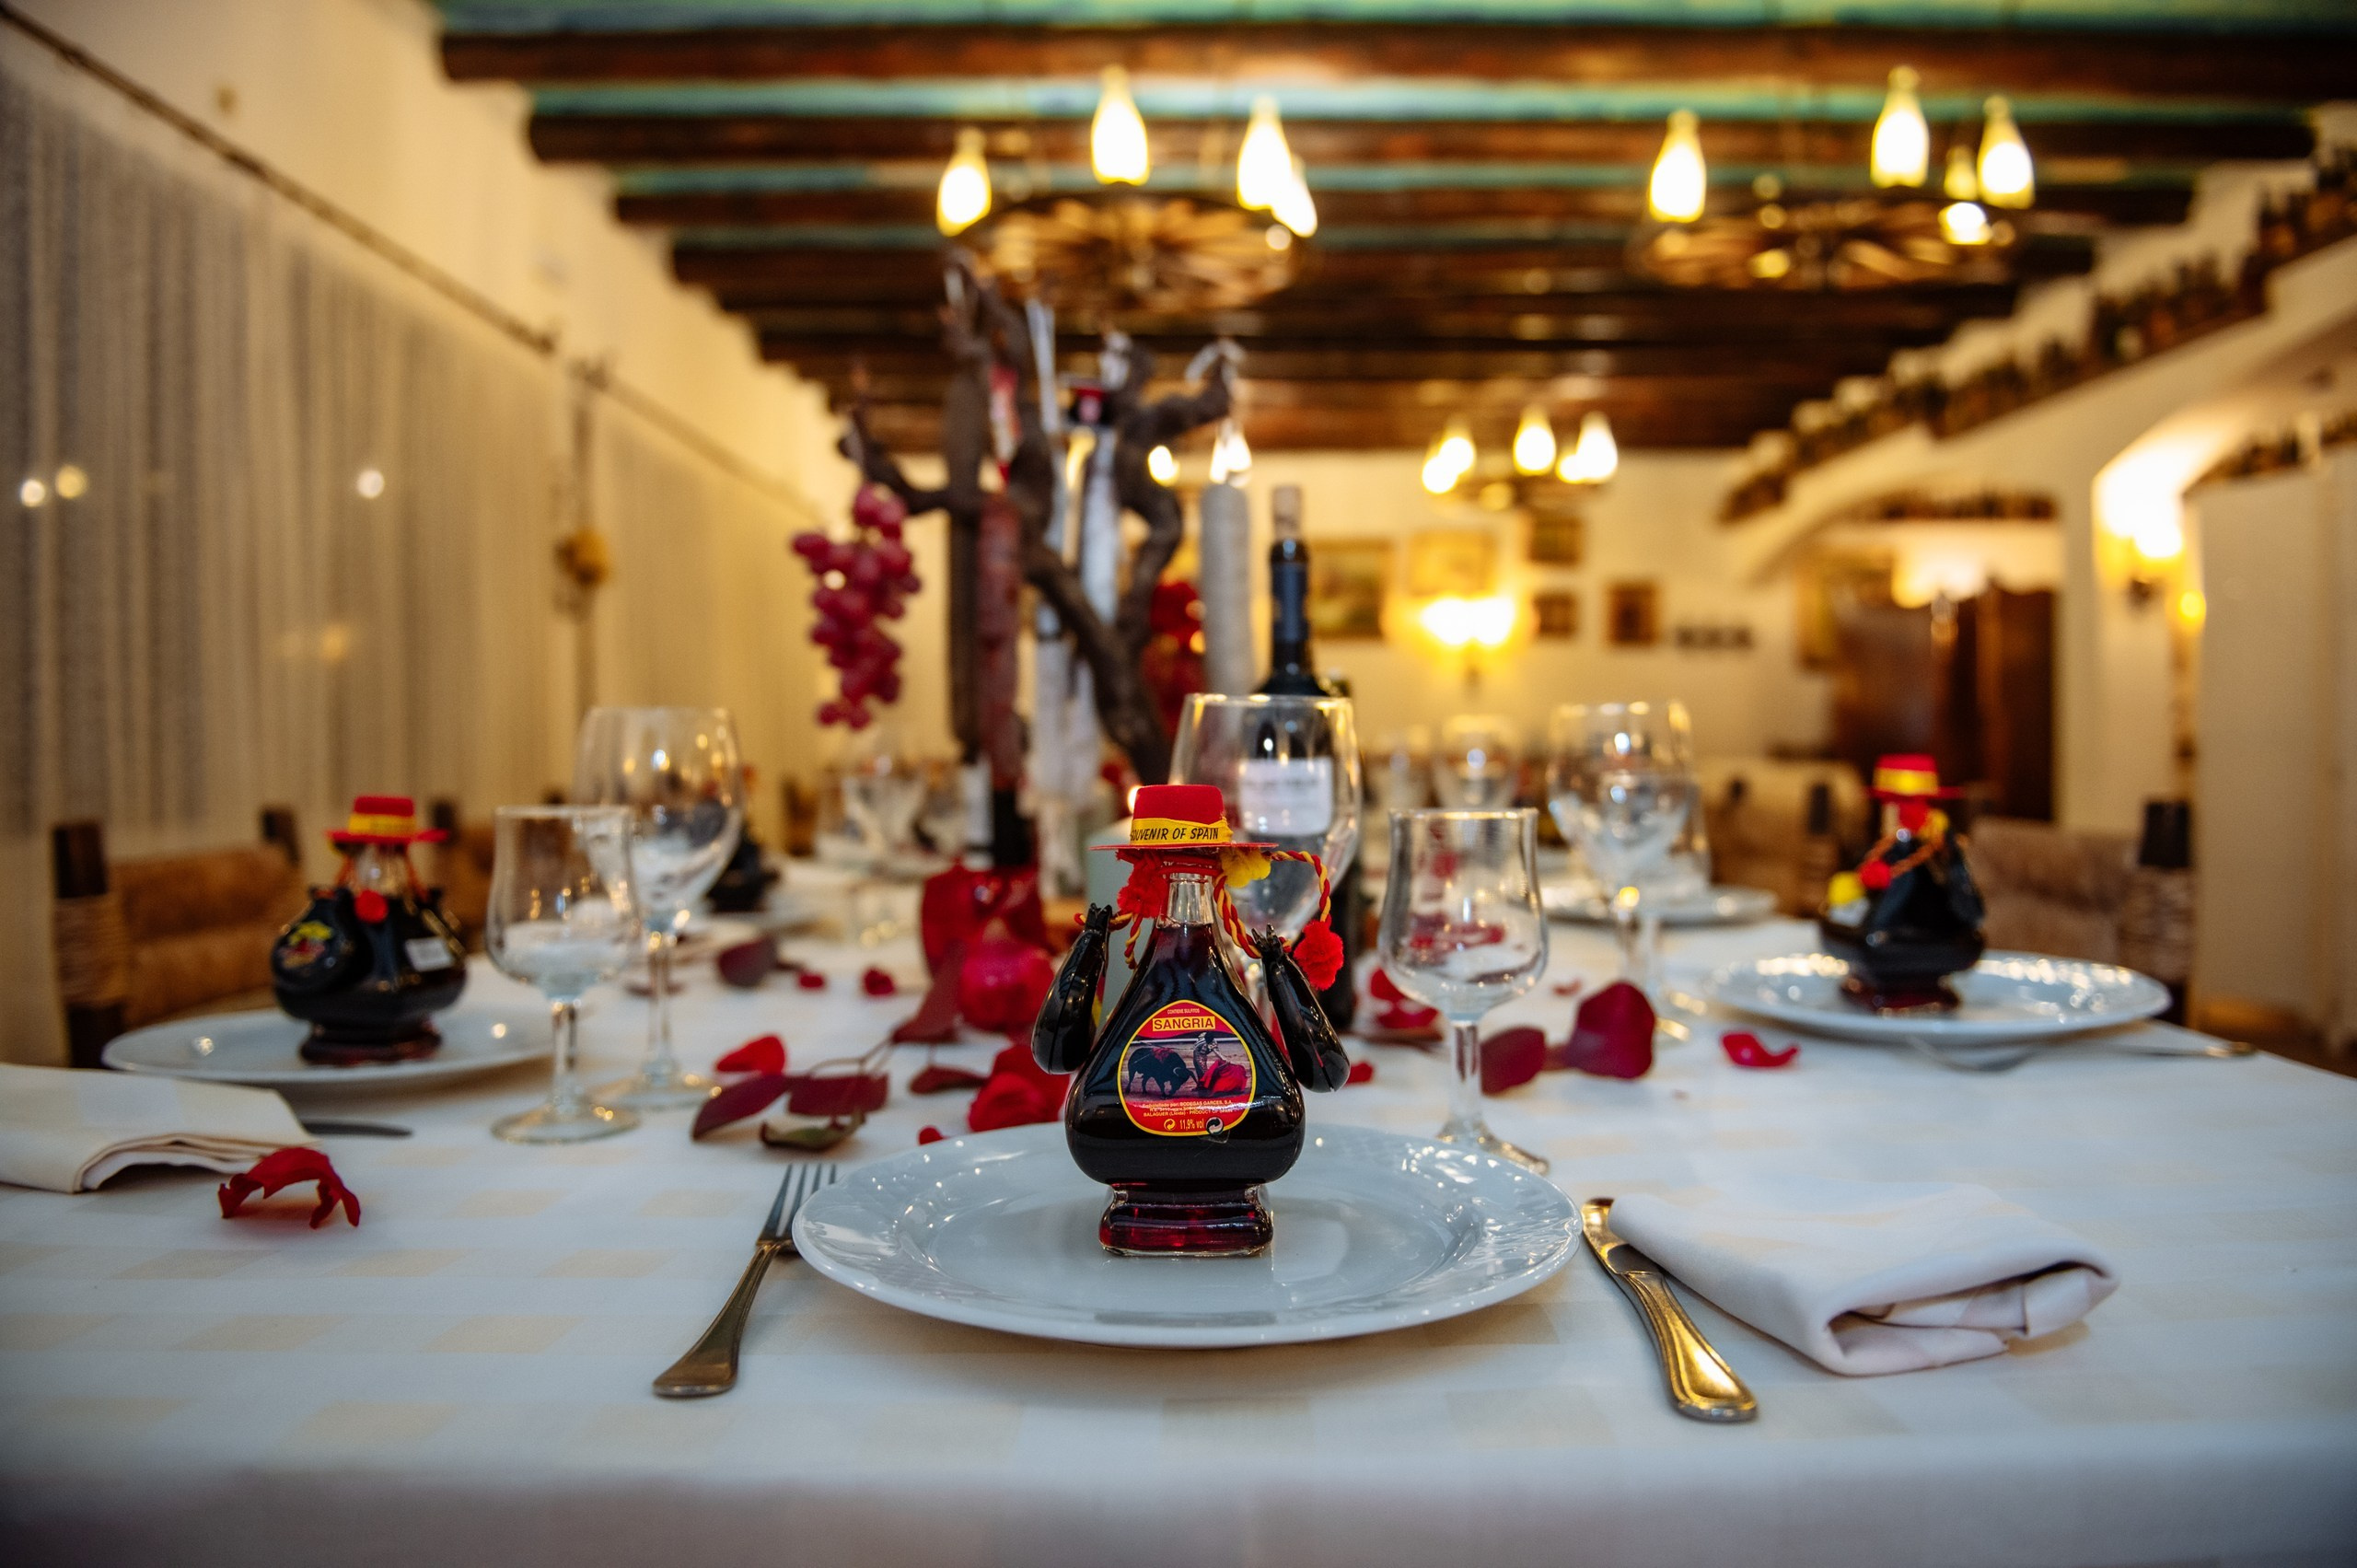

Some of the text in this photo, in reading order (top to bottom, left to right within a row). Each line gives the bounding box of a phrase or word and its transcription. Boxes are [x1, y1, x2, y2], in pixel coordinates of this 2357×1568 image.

[1131, 827, 1219, 842] SOUVENIR OF SPAIN
[1154, 1017, 1213, 1029] SANGRIA
[1179, 1118, 1205, 1131] 11,9% vol
